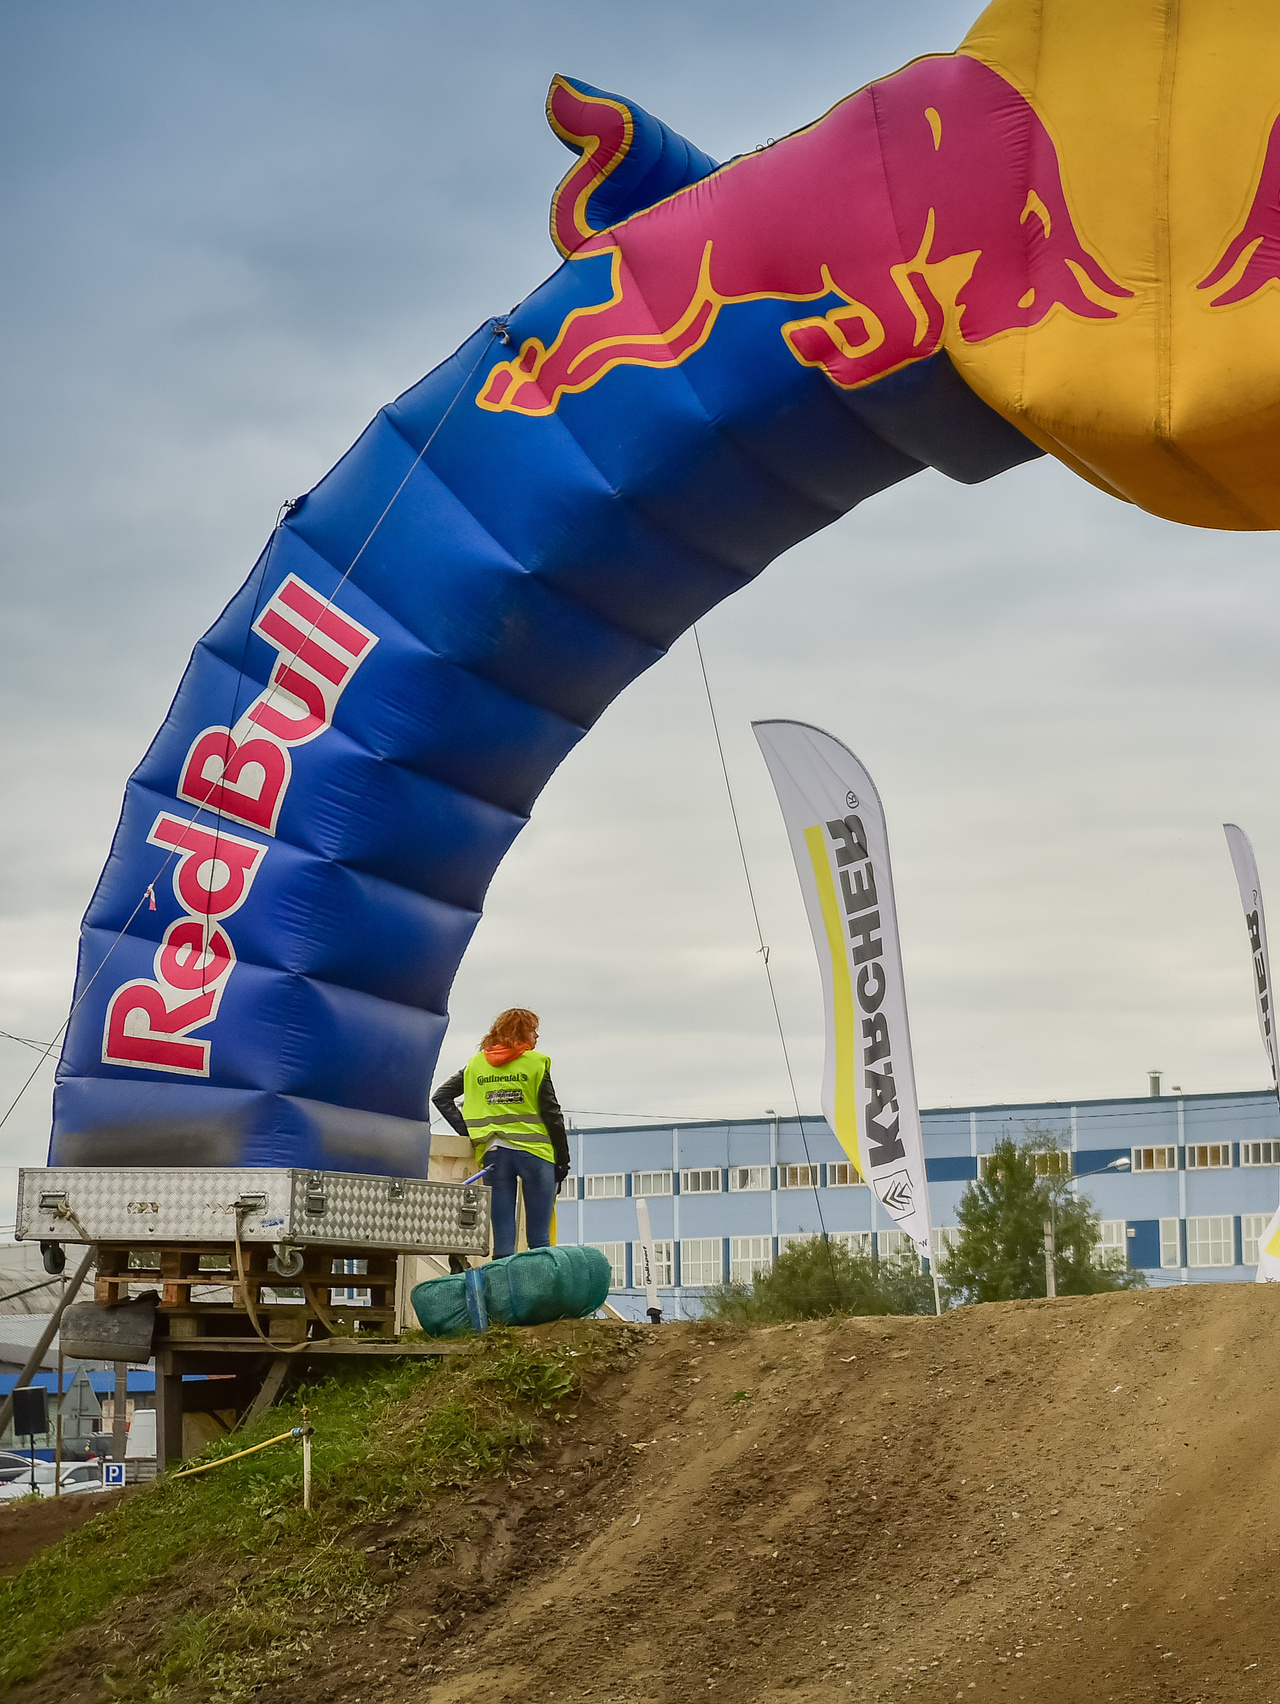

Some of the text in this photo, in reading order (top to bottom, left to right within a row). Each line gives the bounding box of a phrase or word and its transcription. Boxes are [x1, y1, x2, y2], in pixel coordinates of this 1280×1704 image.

[101, 571, 380, 1078] Red Bull
[477, 1074, 520, 1086] Continental
[109, 1466, 119, 1482] P
